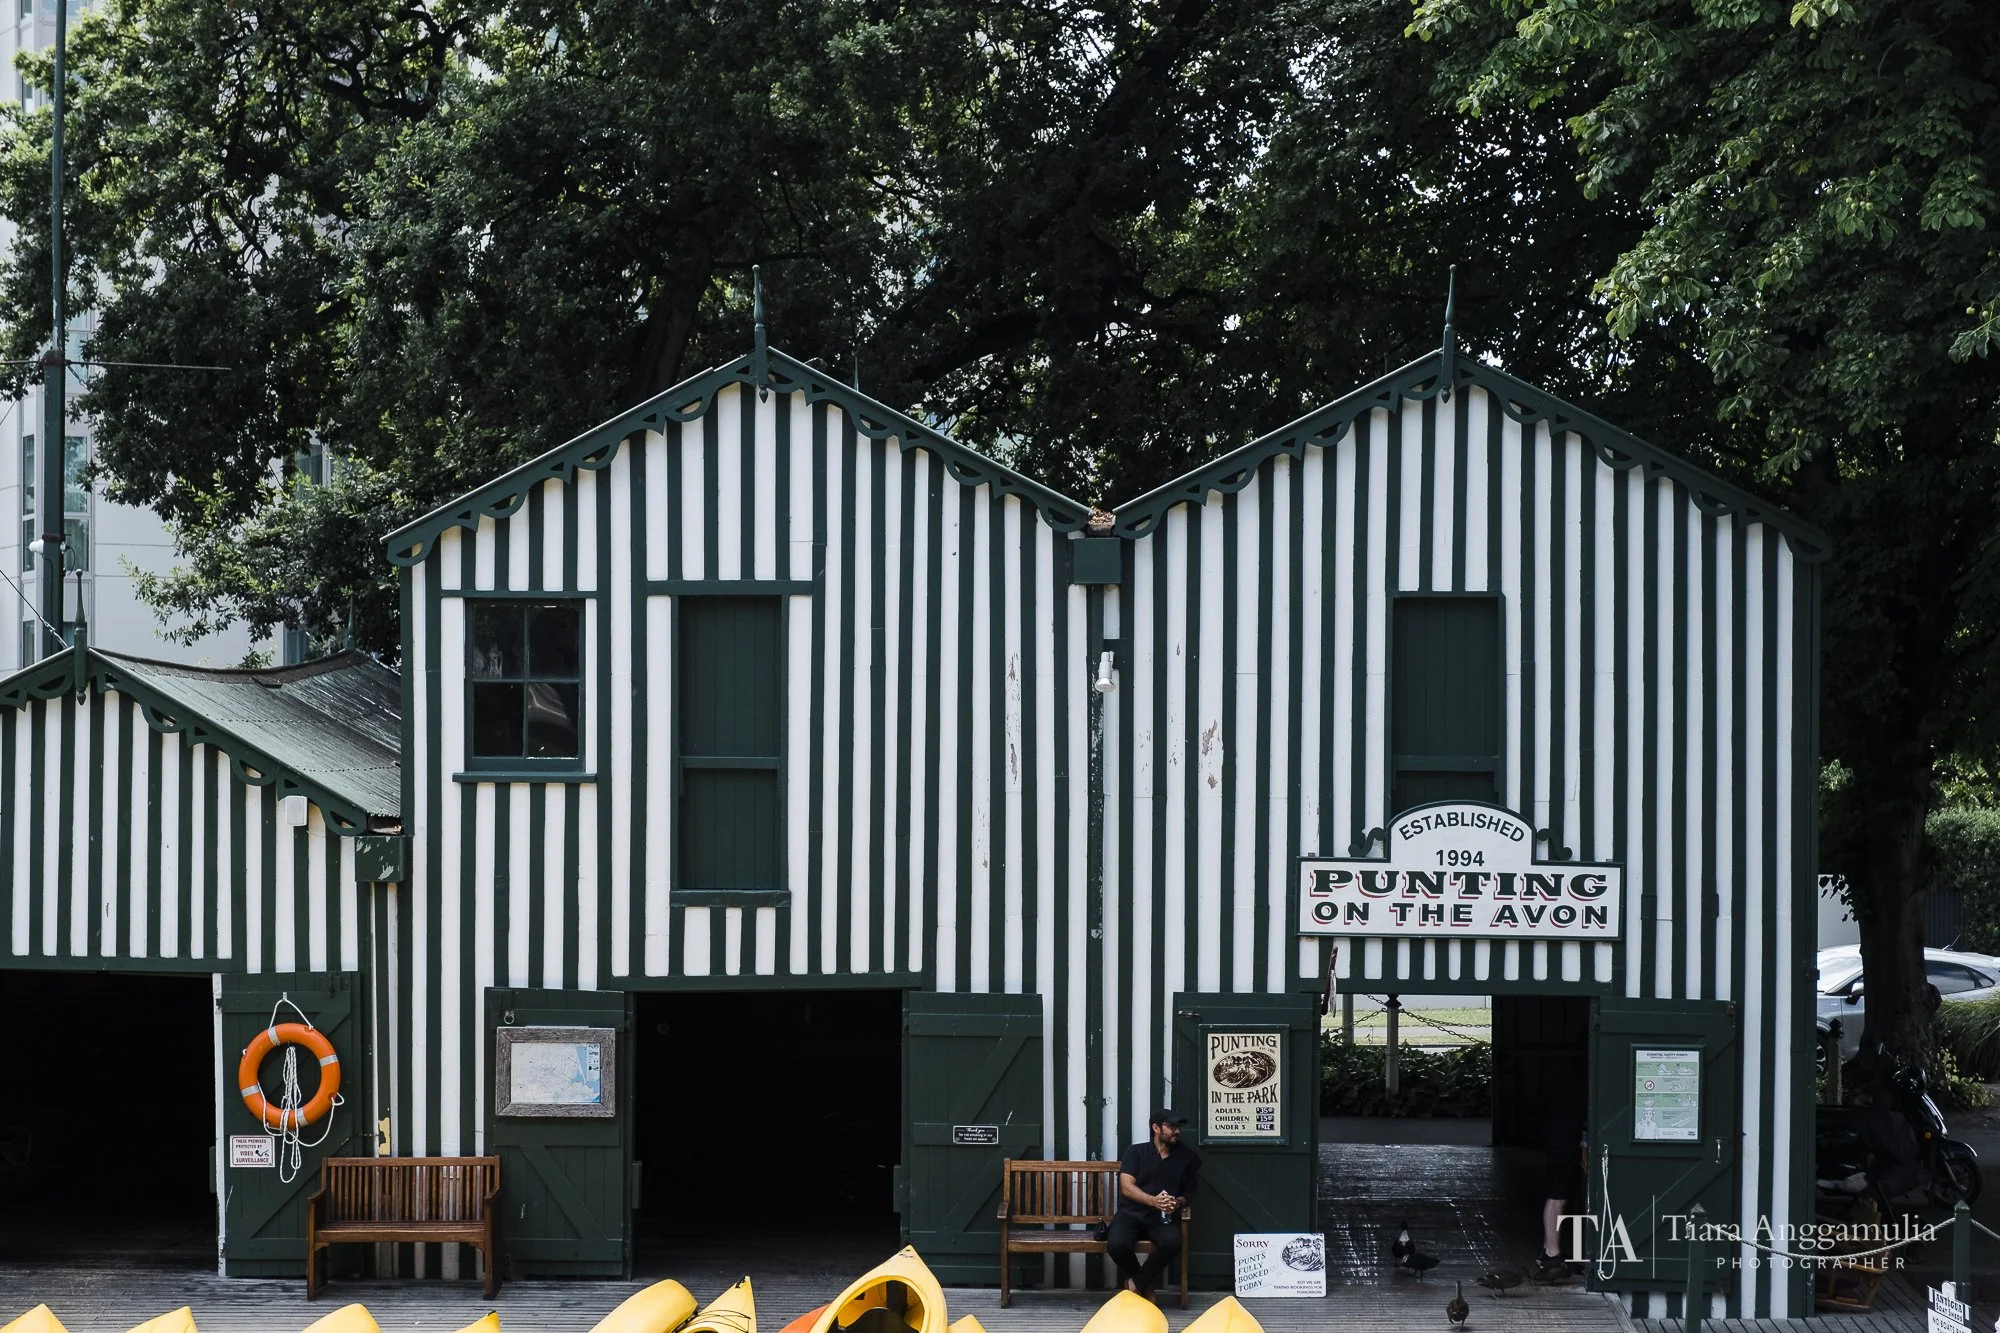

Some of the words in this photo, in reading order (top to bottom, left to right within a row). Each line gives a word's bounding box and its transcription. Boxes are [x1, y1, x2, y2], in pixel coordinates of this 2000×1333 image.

[1398, 811, 1525, 842] ESTABLISHED
[1435, 849, 1485, 867] 1994
[1309, 869, 1608, 902] PUNTING
[1311, 901, 1370, 926] ON
[1389, 902, 1473, 927] THE
[1489, 904, 1608, 929] AVON
[1210, 1035, 1277, 1060] PUNTING
[1211, 1090, 1222, 1104] IN
[1224, 1092, 1245, 1104] THE
[1247, 1083, 1278, 1104] PARK
[1238, 1252, 1266, 1267] PUNTS
[1238, 1261, 1264, 1275] FULLY
[1238, 1268, 1269, 1284] BOOKED
[1238, 1279, 1263, 1292] TODAY
